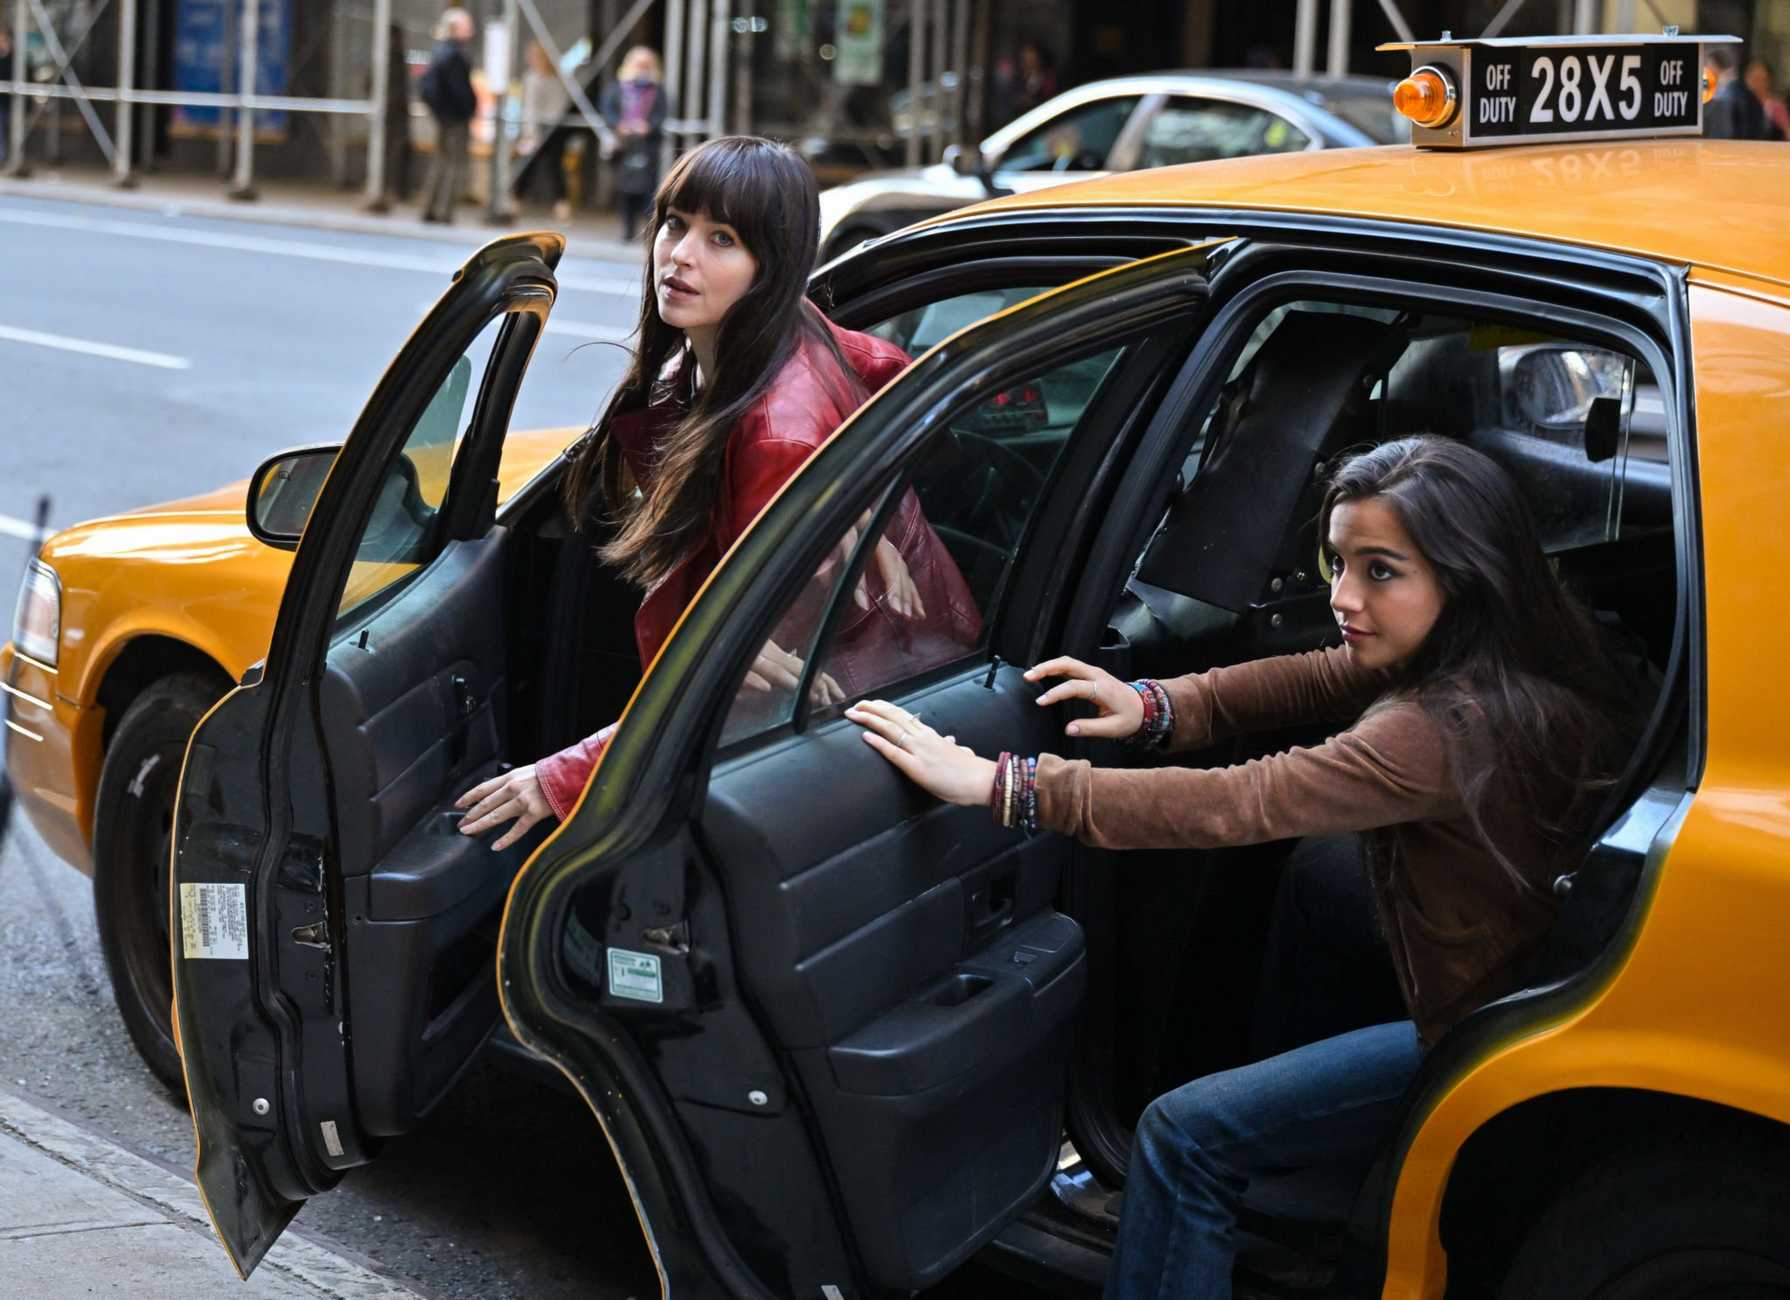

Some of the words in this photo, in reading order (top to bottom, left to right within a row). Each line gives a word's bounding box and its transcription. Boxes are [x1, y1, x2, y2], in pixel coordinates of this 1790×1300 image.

[1486, 64, 1511, 91] OFF
[1660, 60, 1683, 86] OFF
[1529, 54, 1642, 123] 28X5
[1479, 96, 1516, 124] DUTY
[1654, 91, 1688, 118] DUTY
